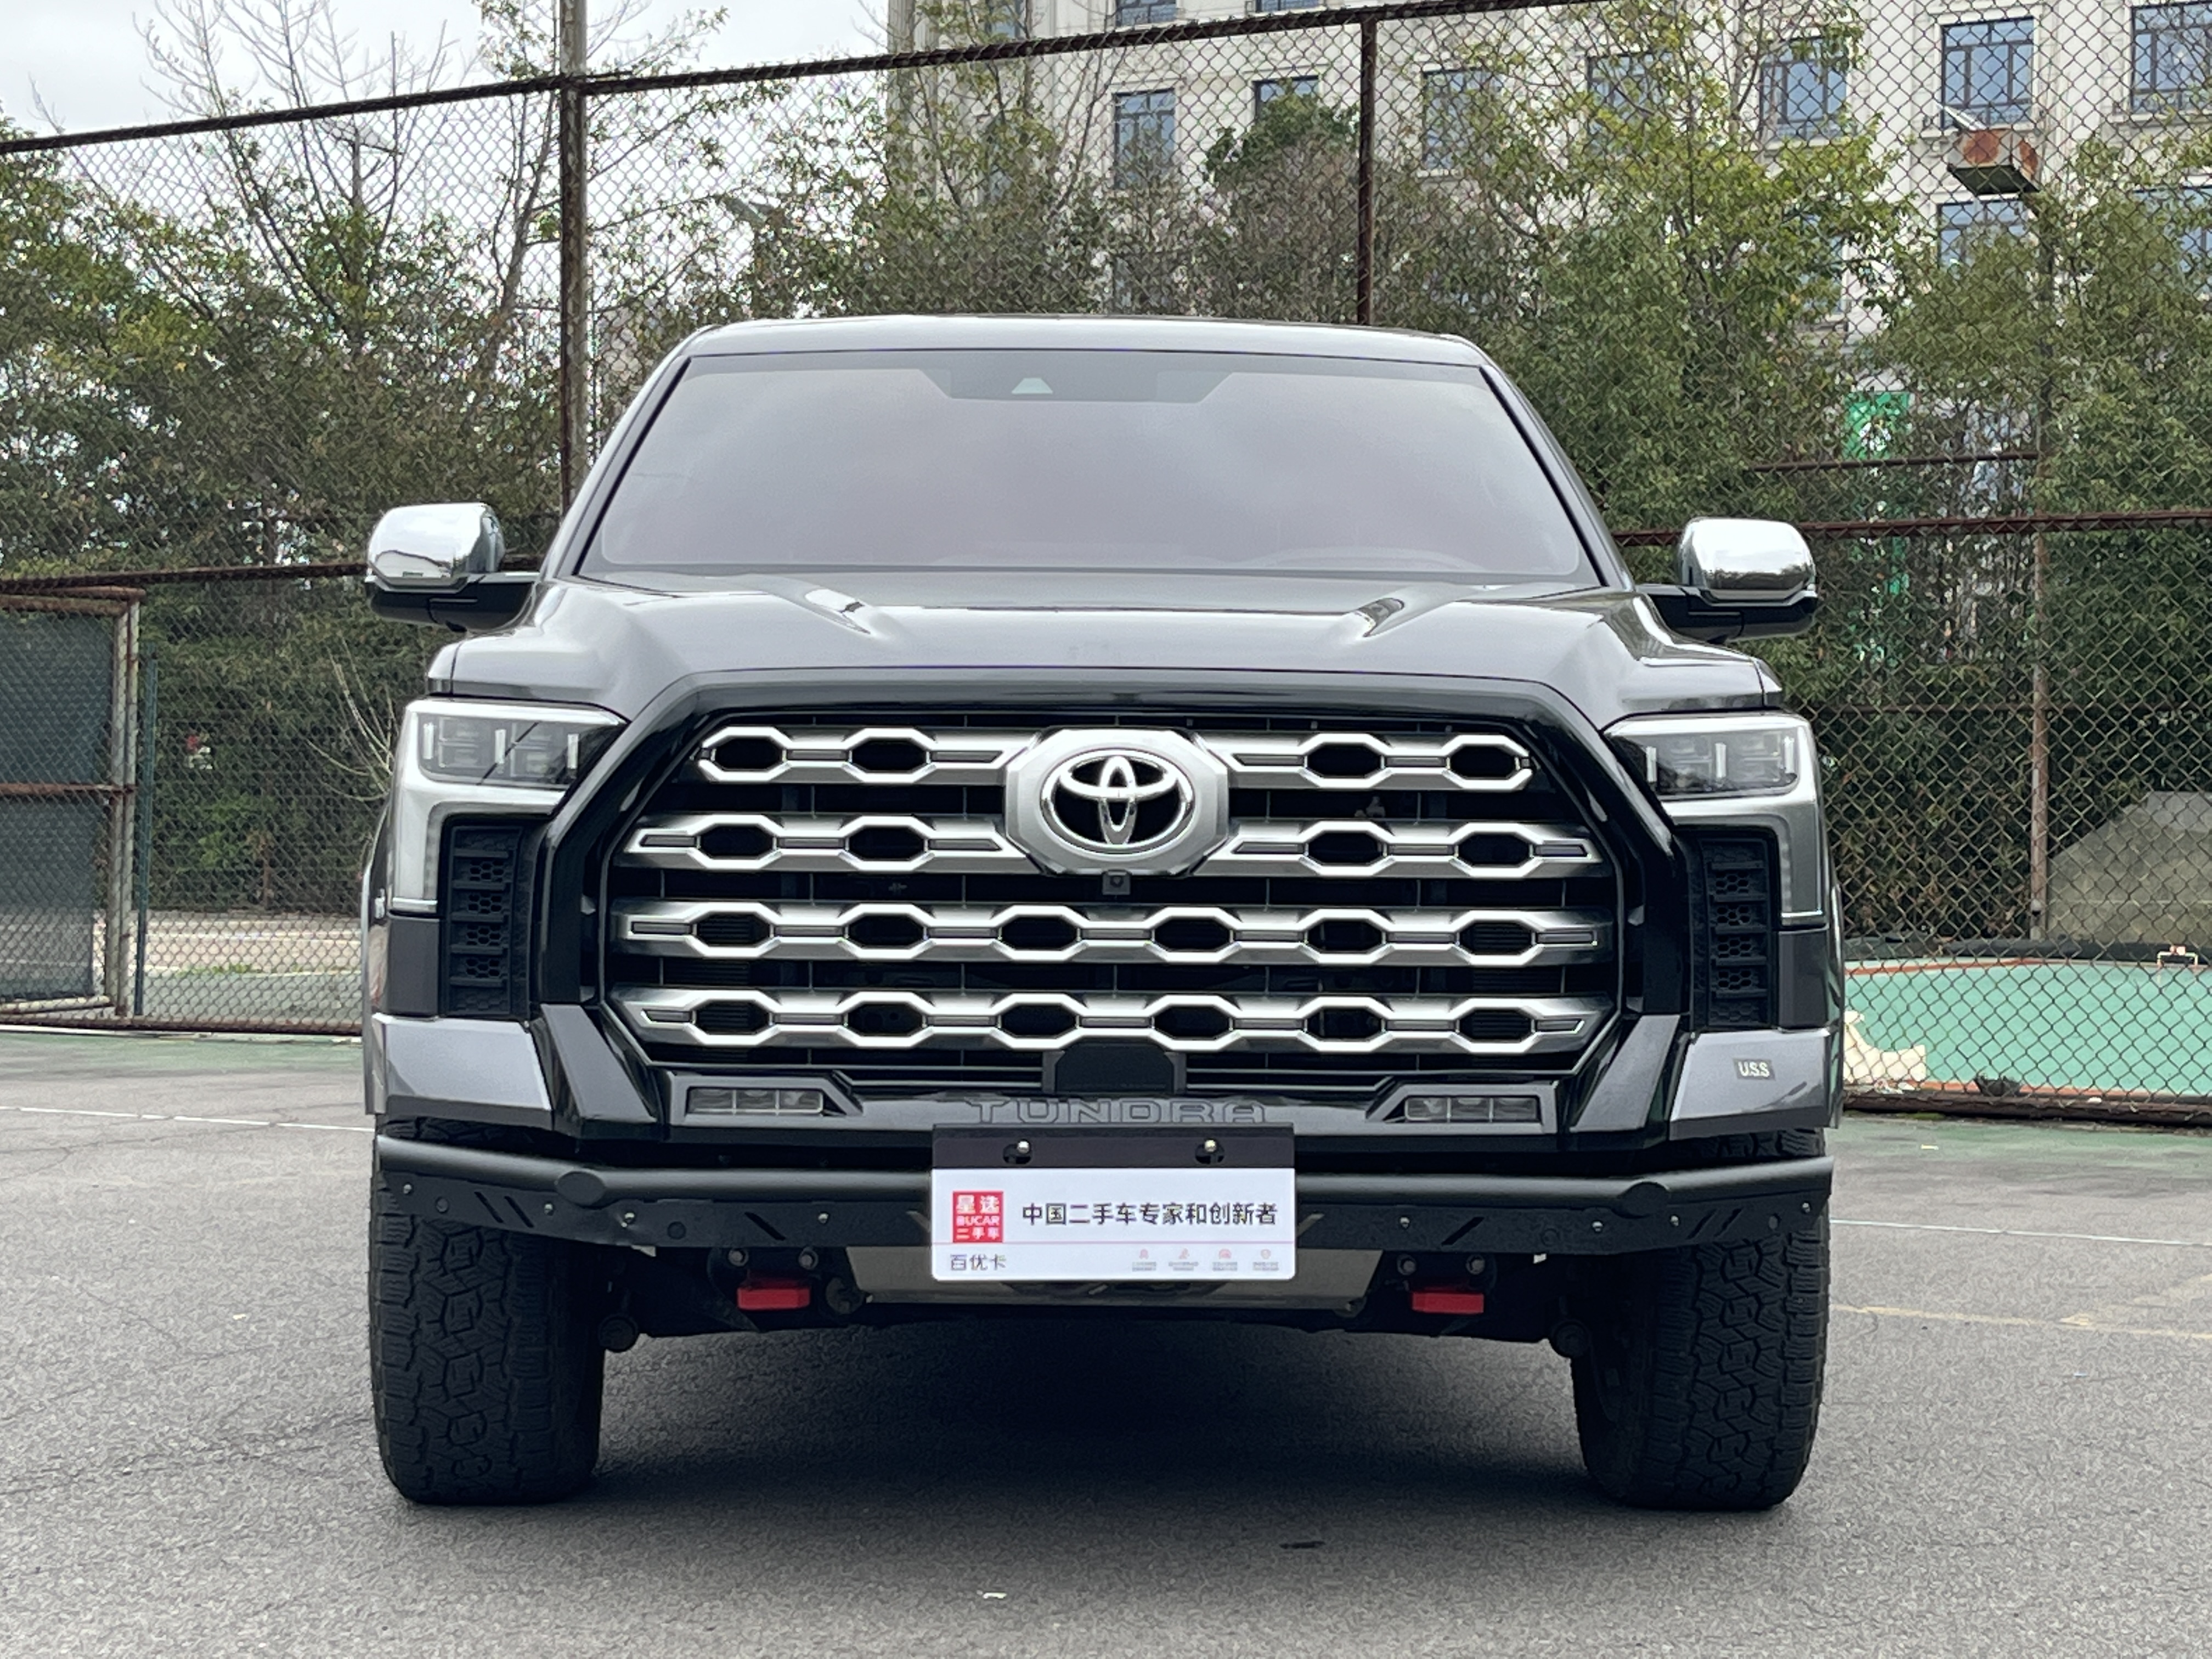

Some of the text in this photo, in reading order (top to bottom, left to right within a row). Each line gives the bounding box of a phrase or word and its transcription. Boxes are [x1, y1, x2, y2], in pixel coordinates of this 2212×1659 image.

[964, 1097, 1265, 1124] TUNDRA
[957, 1215, 1000, 1226] BUCAR
[1022, 1203, 1278, 1226] 中国二手车专家和创新者
[956, 1227, 1000, 1240] 二手车
[950, 1254, 1007, 1271] 百优卡
